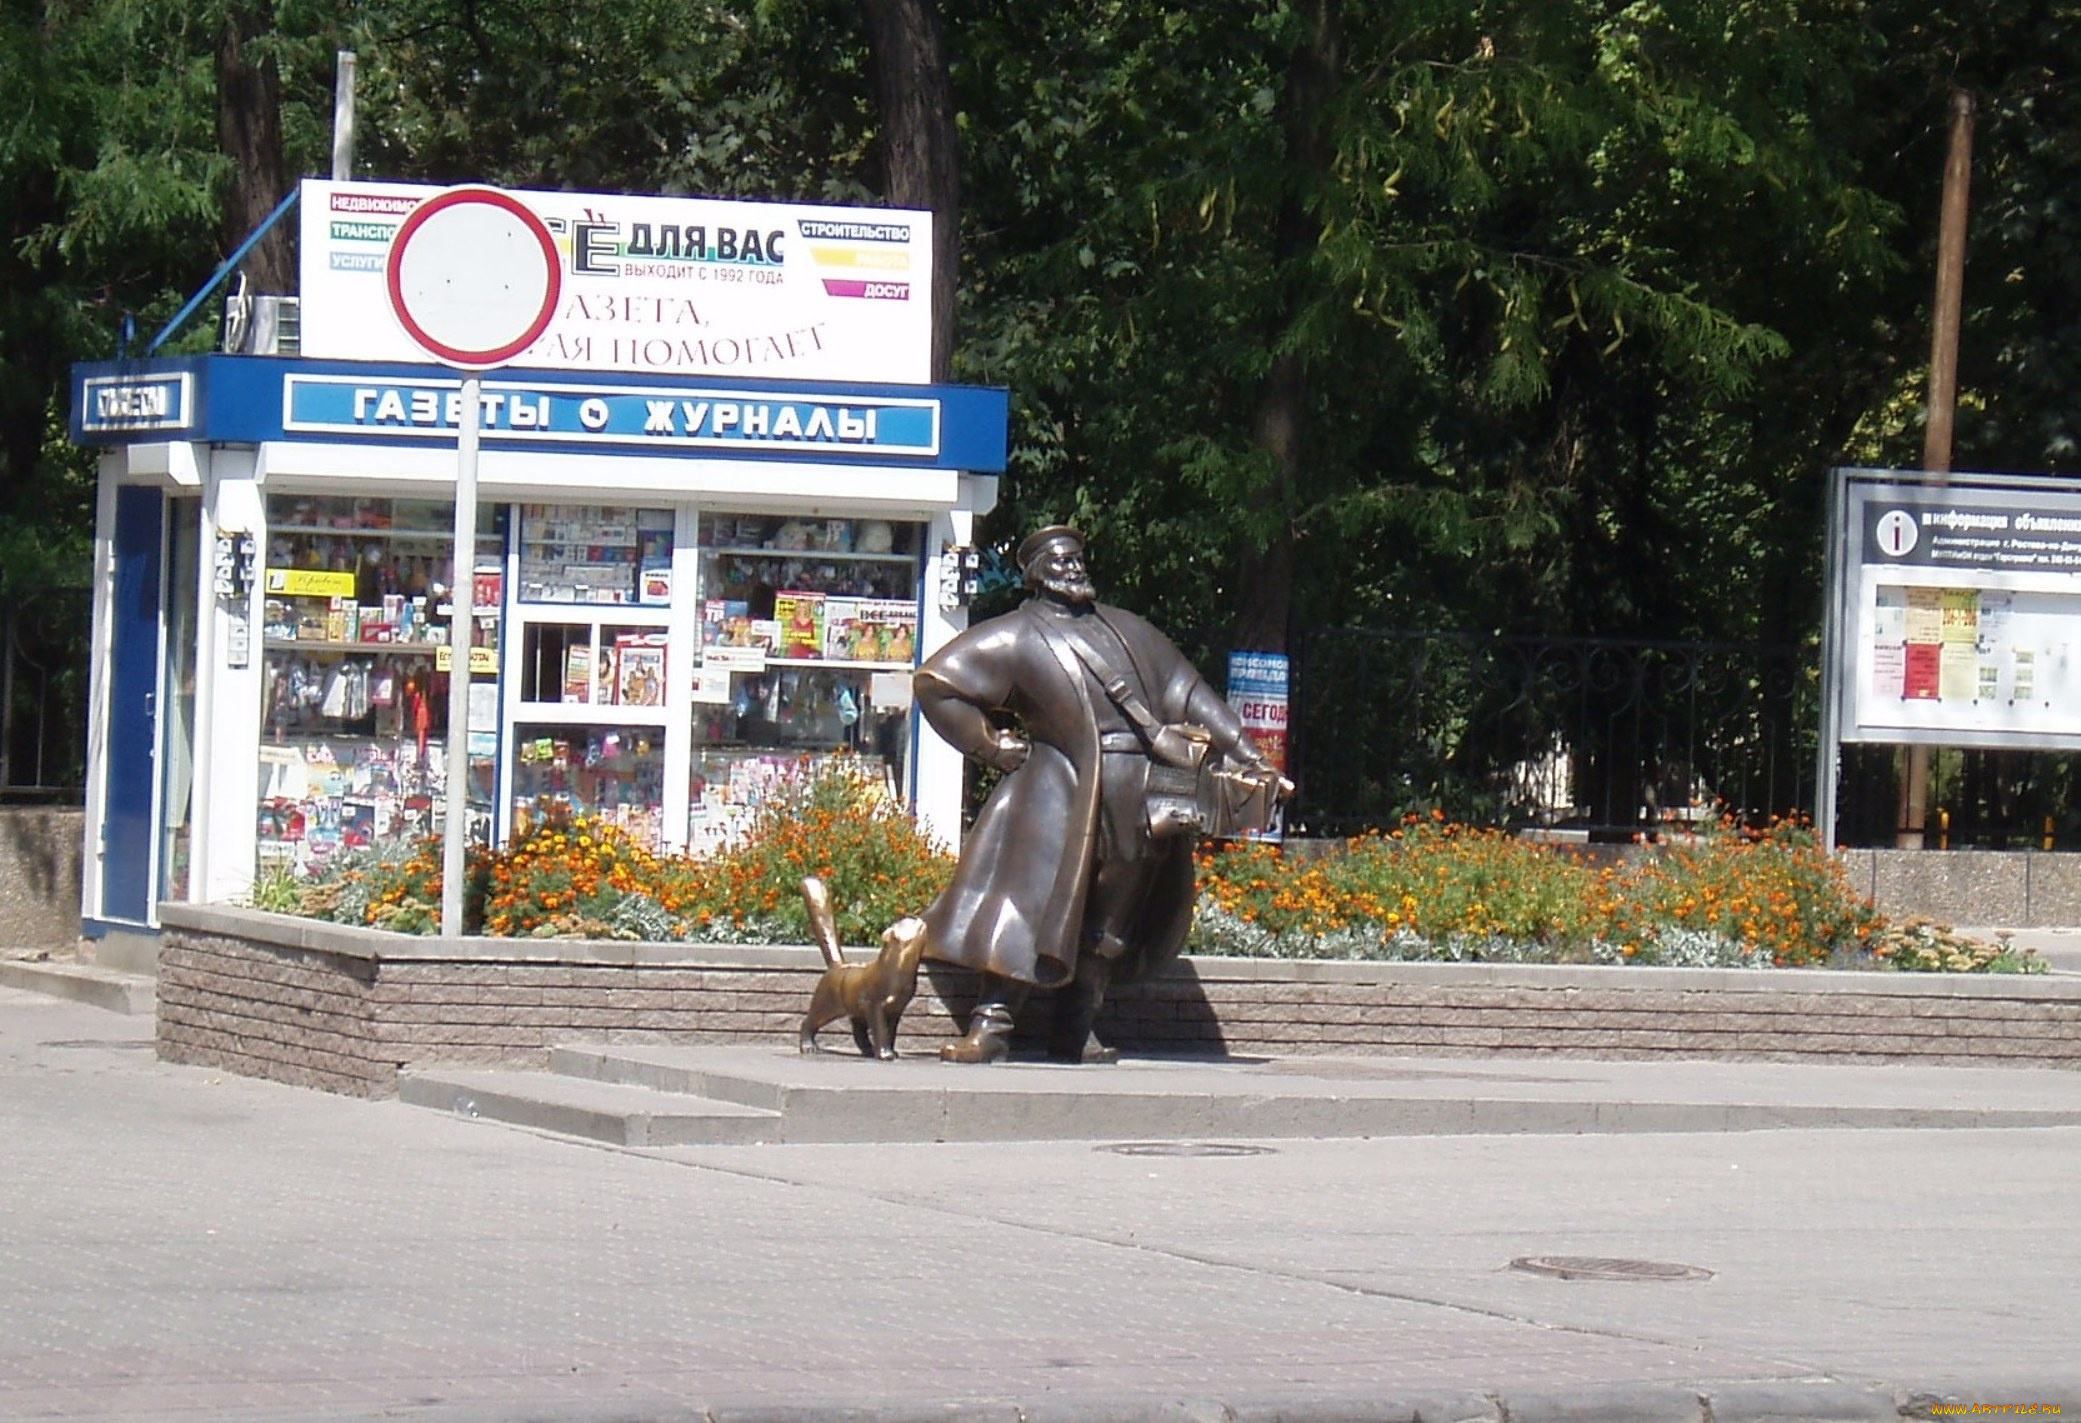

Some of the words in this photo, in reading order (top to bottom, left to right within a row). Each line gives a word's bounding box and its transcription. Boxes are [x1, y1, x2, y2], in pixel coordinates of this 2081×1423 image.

[332, 196, 417, 213] НЕДВИЖИМО
[332, 223, 396, 240] ТРАНСПО
[628, 222, 705, 259] ДЛЯ
[717, 227, 784, 263] ВАС
[801, 222, 909, 241] СТРОИТЕЛЬСТВО
[625, 263, 694, 280] ВЫХОДИТ
[699, 268, 707, 281] С
[714, 269, 743, 284] 1992
[748, 271, 784, 286] ГОДА
[865, 283, 908, 299] ДОСУГ
[566, 294, 709, 328] АЗЕТА,
[613, 322, 825, 366] ПОМОГАЕТ
[644, 400, 876, 440] ЖУРНАЛЫ
[2015, 513, 2081, 532] объявлени
[1243, 702, 1289, 724] СЕГОД
